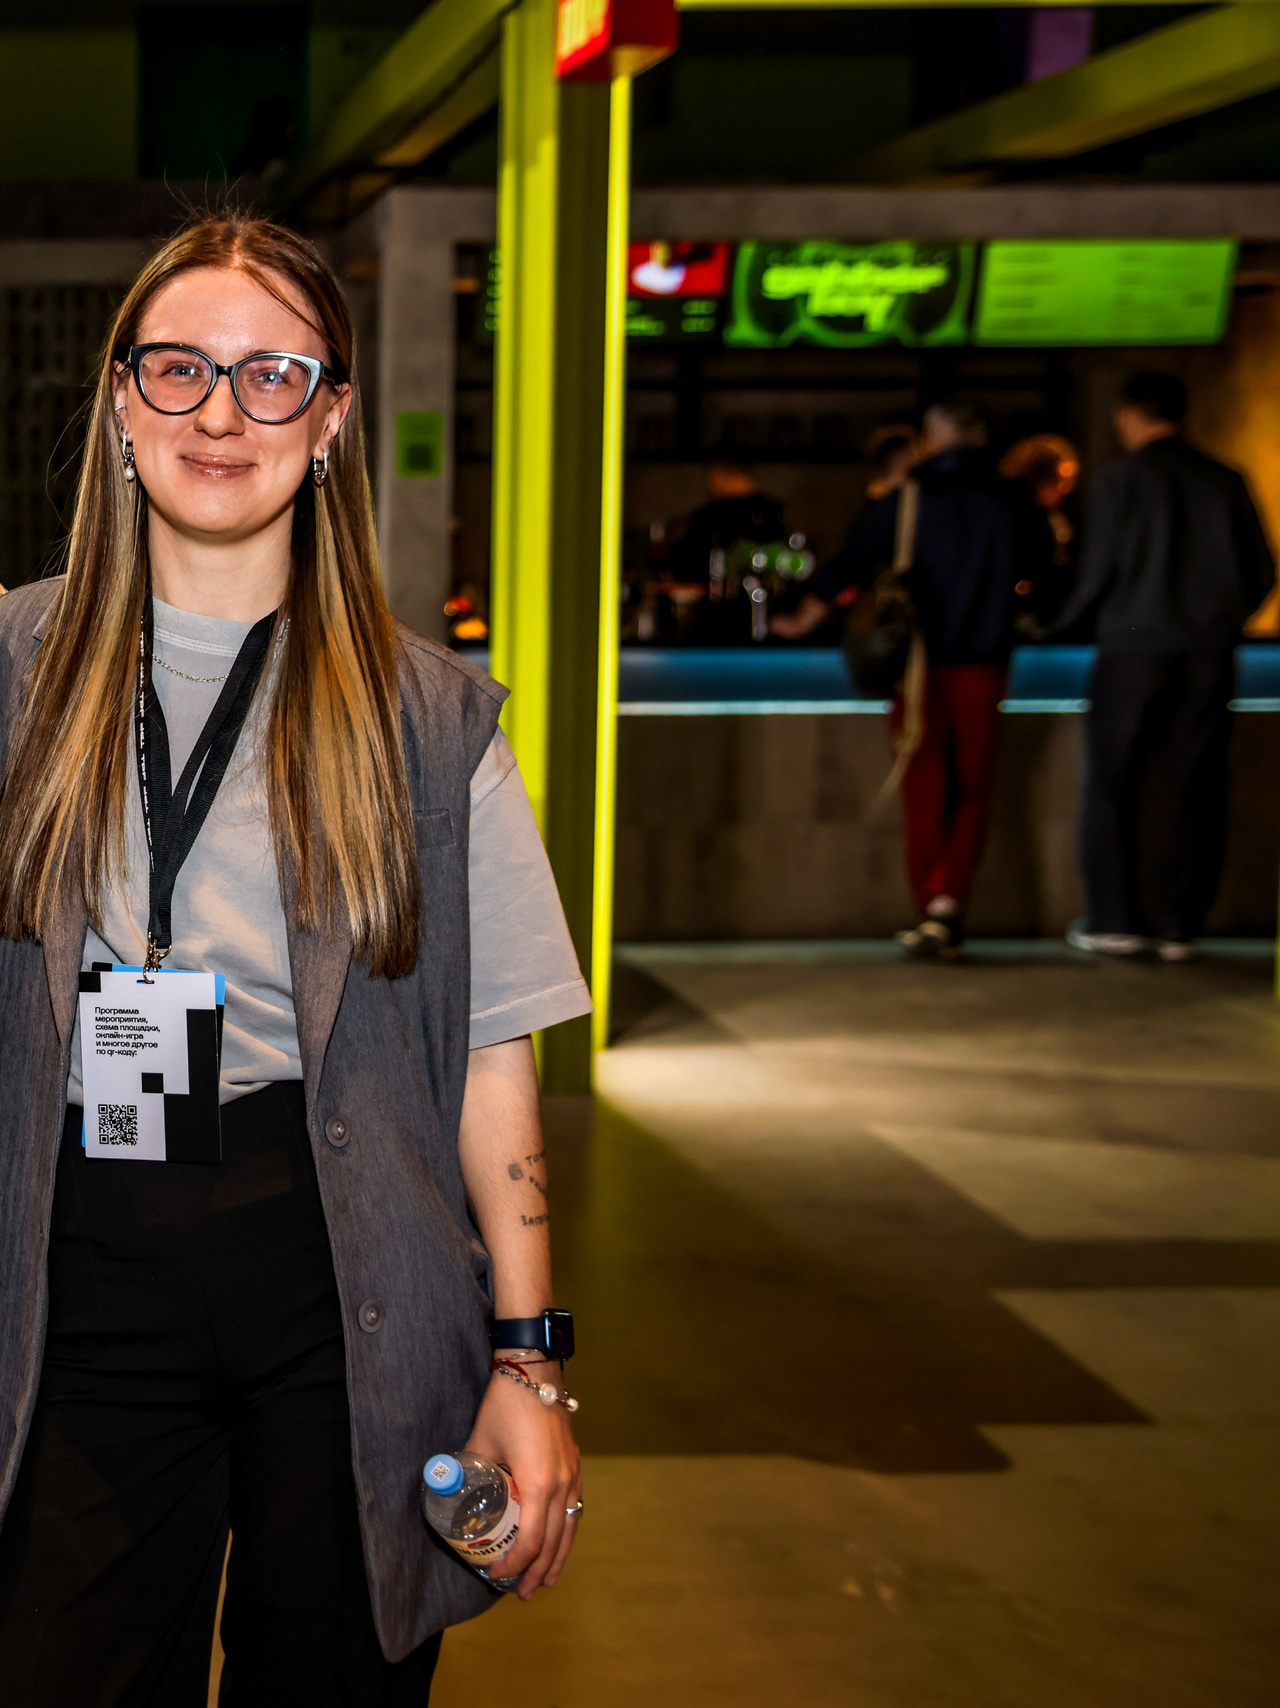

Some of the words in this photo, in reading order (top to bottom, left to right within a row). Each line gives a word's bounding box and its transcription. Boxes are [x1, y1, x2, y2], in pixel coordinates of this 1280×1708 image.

[95, 1006, 139, 1015] Программа
[95, 1016, 148, 1024] мероприятия,
[95, 1032, 144, 1040] онлайн-игра
[107, 1049, 137, 1057] qr-коду:
